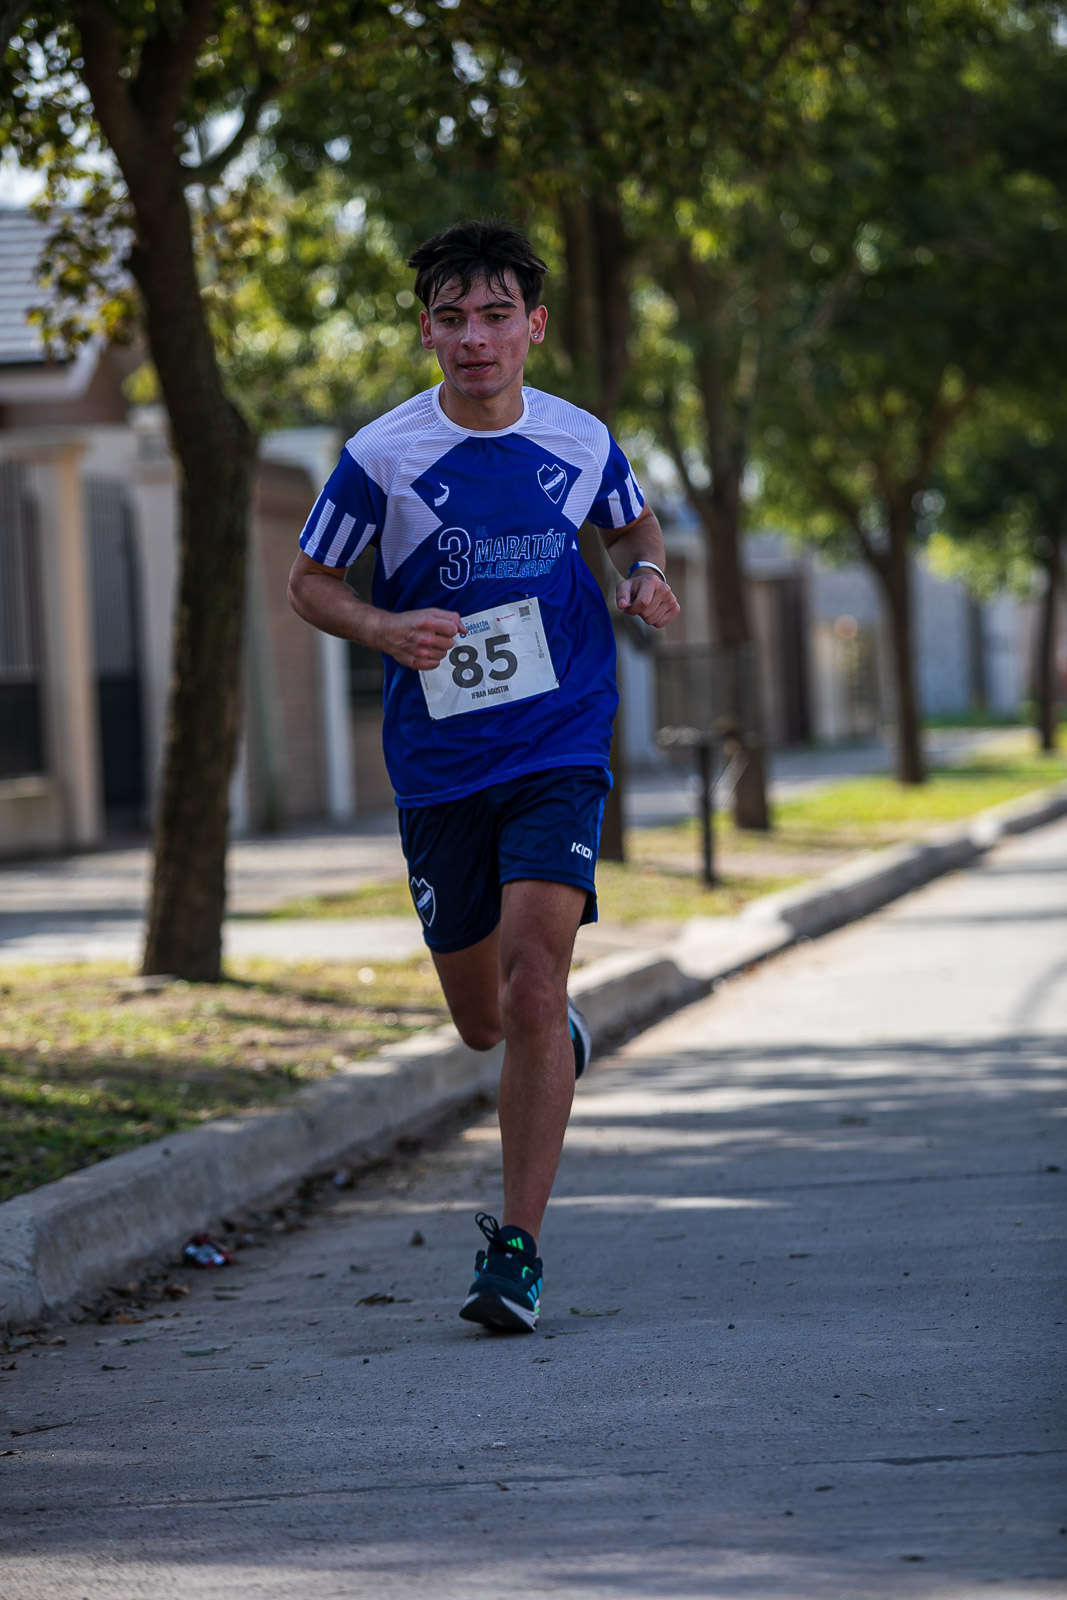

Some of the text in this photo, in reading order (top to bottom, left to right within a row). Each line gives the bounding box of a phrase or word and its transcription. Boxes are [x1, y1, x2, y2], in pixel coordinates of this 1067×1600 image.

[438, 527, 472, 590] 3
[474, 528, 567, 563] MARATÓN
[449, 633, 518, 689] 85
